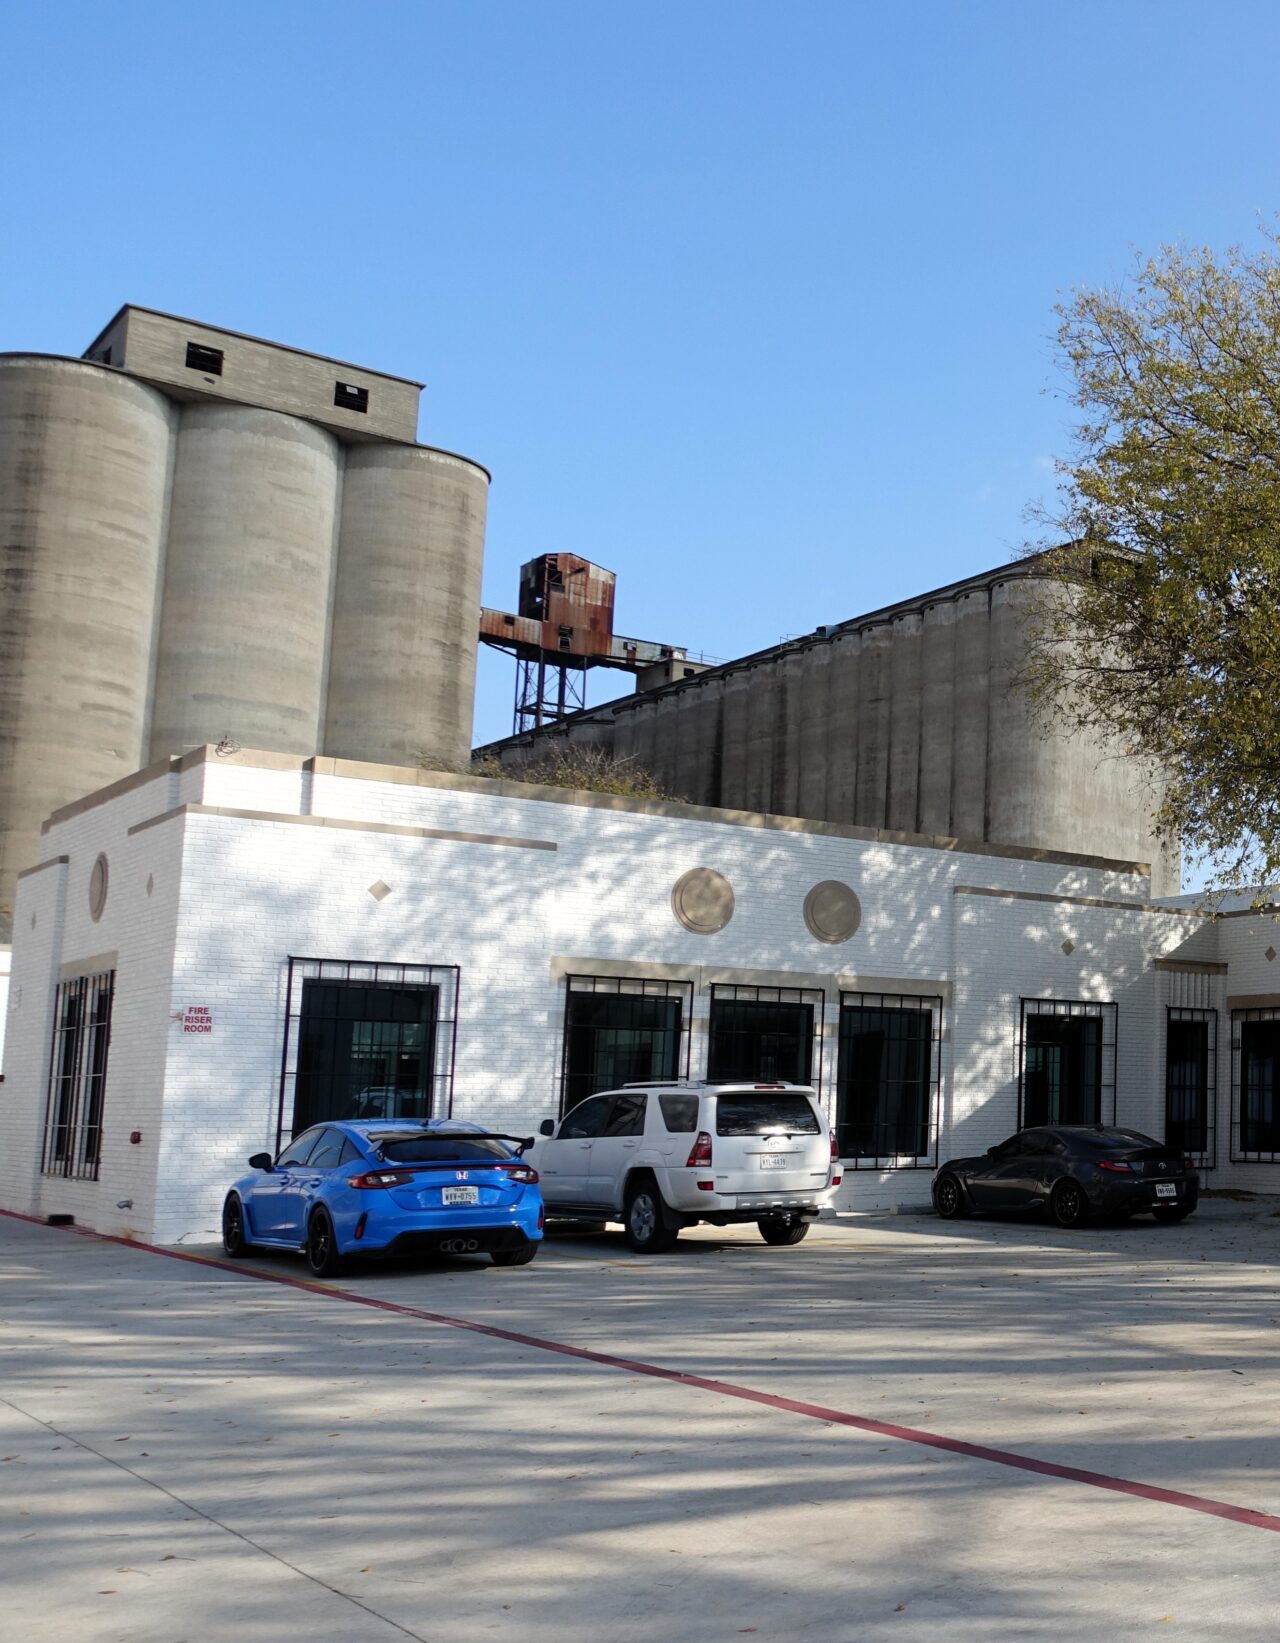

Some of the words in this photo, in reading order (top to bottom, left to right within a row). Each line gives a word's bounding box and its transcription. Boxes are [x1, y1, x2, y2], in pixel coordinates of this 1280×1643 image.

[188, 1007, 210, 1015] FIRE
[184, 1016, 212, 1024] RISER
[184, 1025, 212, 1033] ROOM
